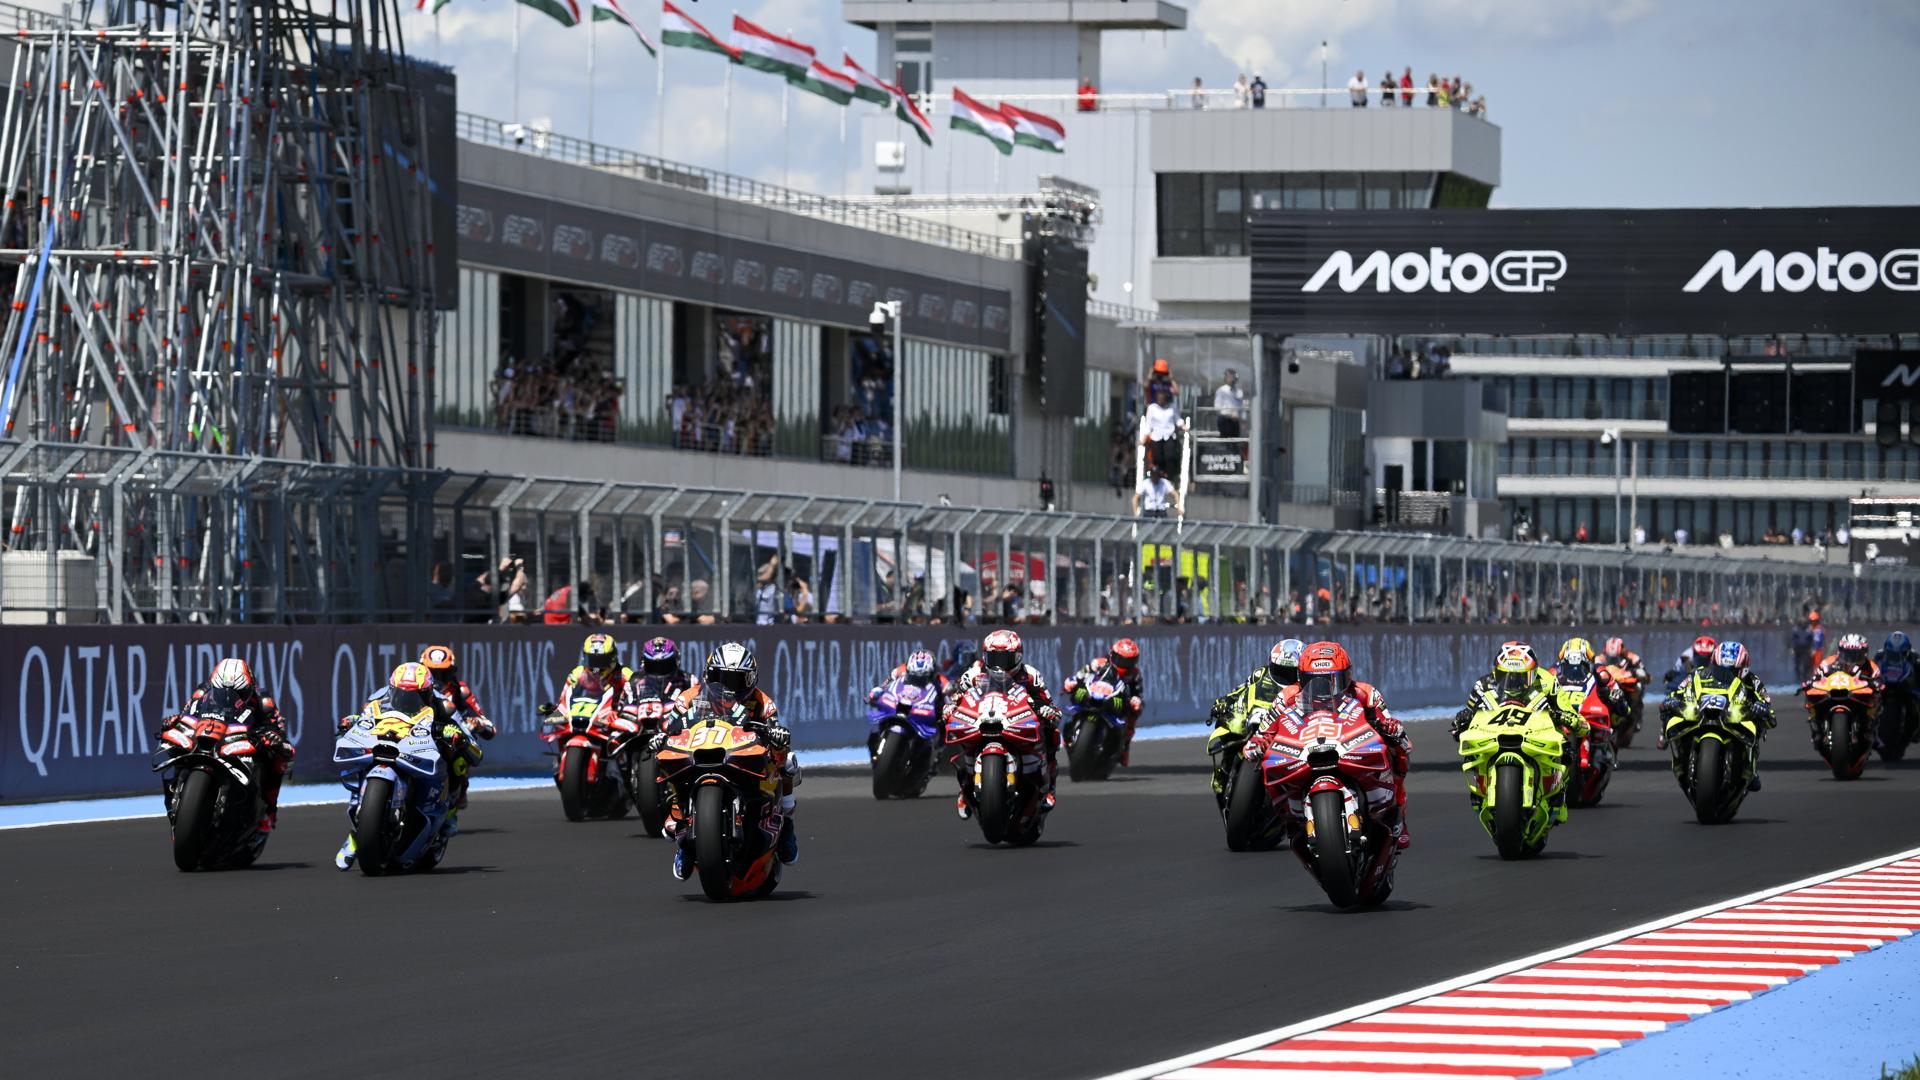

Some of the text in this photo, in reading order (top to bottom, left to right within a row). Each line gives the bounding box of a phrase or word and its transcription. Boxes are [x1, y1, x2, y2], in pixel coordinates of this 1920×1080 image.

[1301, 247, 1568, 293] MotoGP
[1682, 247, 1920, 293] MotoG
[461, 640, 555, 734] RWAYS
[773, 639, 842, 728] QATAR
[1829, 674, 1851, 688] 23
[19, 640, 304, 776] QATAR AIAYS
[953, 711, 977, 725] Lenovo
[1009, 710, 1033, 725] Lenovo
[1487, 707, 1533, 727] 49
[690, 726, 730, 749] 37
[1299, 722, 1342, 742] 93
[1343, 730, 1375, 750] Lenovo
[1271, 742, 1302, 756] Lenovo
